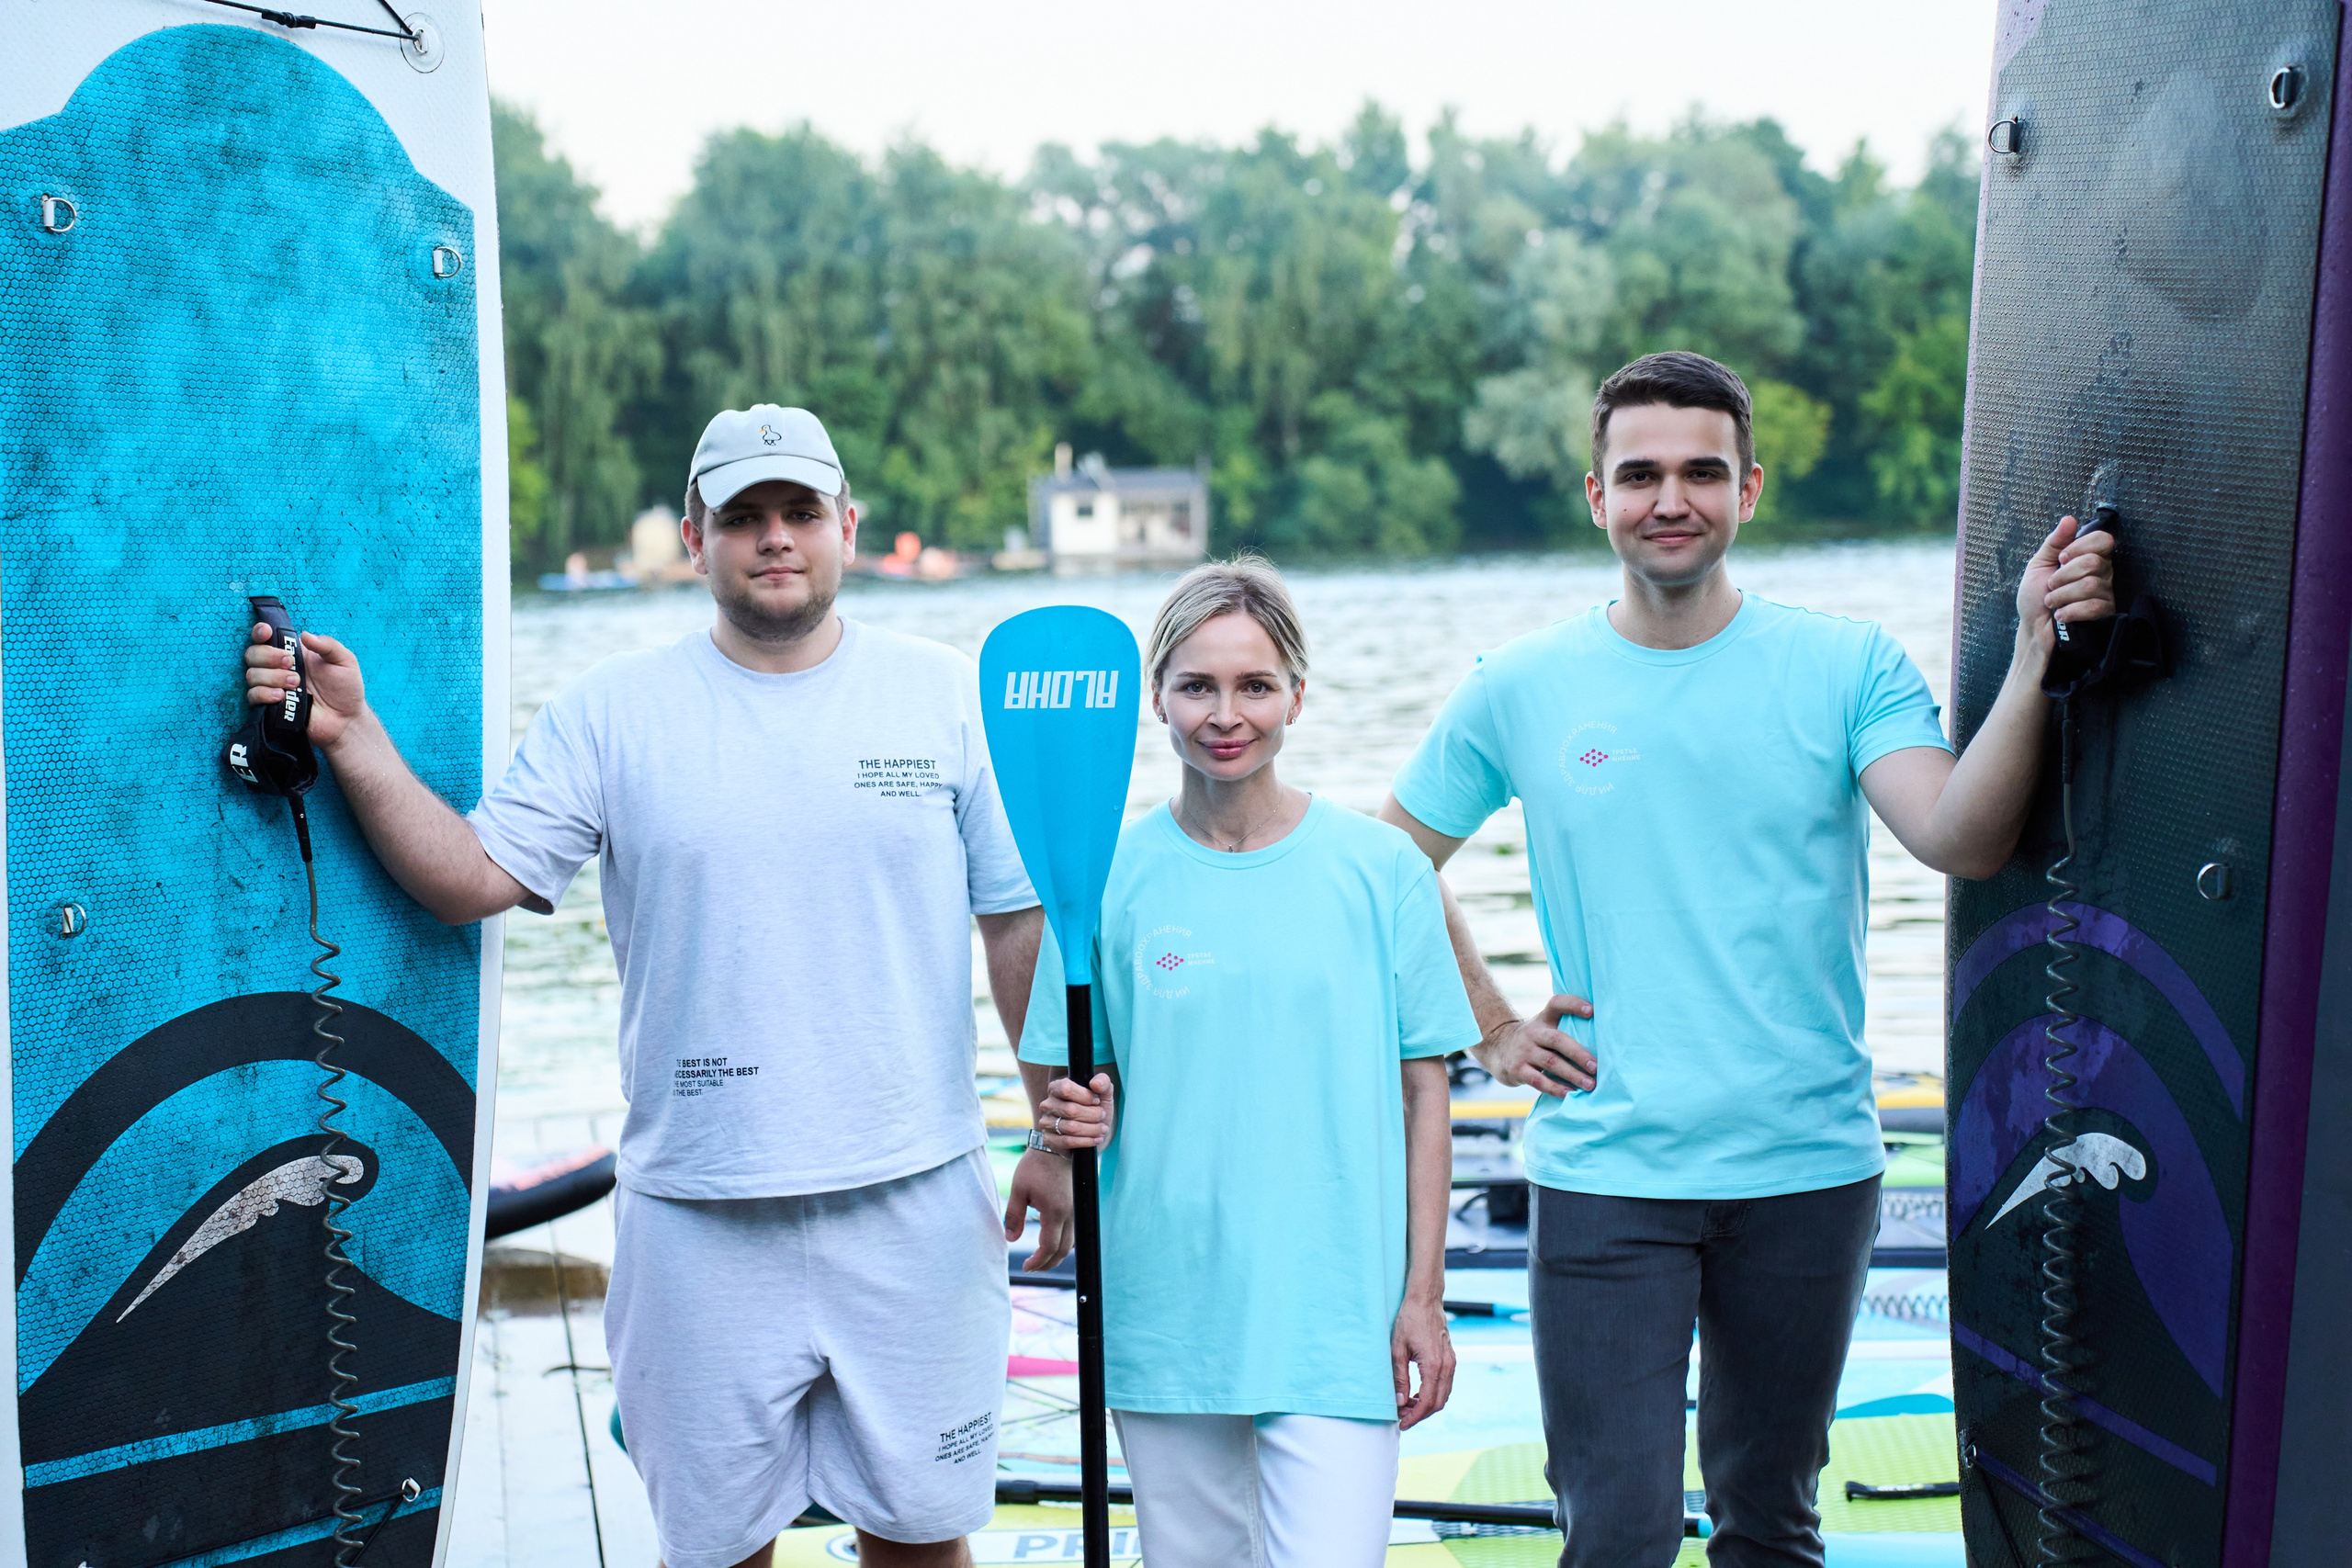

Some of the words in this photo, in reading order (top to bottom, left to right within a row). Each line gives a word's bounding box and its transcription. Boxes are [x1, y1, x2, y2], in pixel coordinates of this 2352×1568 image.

[1003, 671, 1119, 709] ALOHA
[858, 760, 881, 770] THE
[884, 759, 936, 770] HAPPIEST
[915, 772, 940, 780] LOVED
[682, 1058, 701, 1067] BEST
[703, 1057, 710, 1066] IS
[712, 1057, 728, 1066] NOT
[718, 1067, 734, 1077] THE
[736, 1066, 759, 1077] BEST
[697, 1078, 723, 1087] SUITABLE
[940, 1428, 956, 1442] THE
[957, 1412, 991, 1437] HAPPIEST
[942, 1440, 957, 1451] HOPE
[958, 1437, 969, 1446] ALL
[970, 1433, 978, 1441] MY
[935, 1451, 952, 1461] ONES
[953, 1447, 965, 1456] ARE
[954, 1455, 966, 1464] AND
